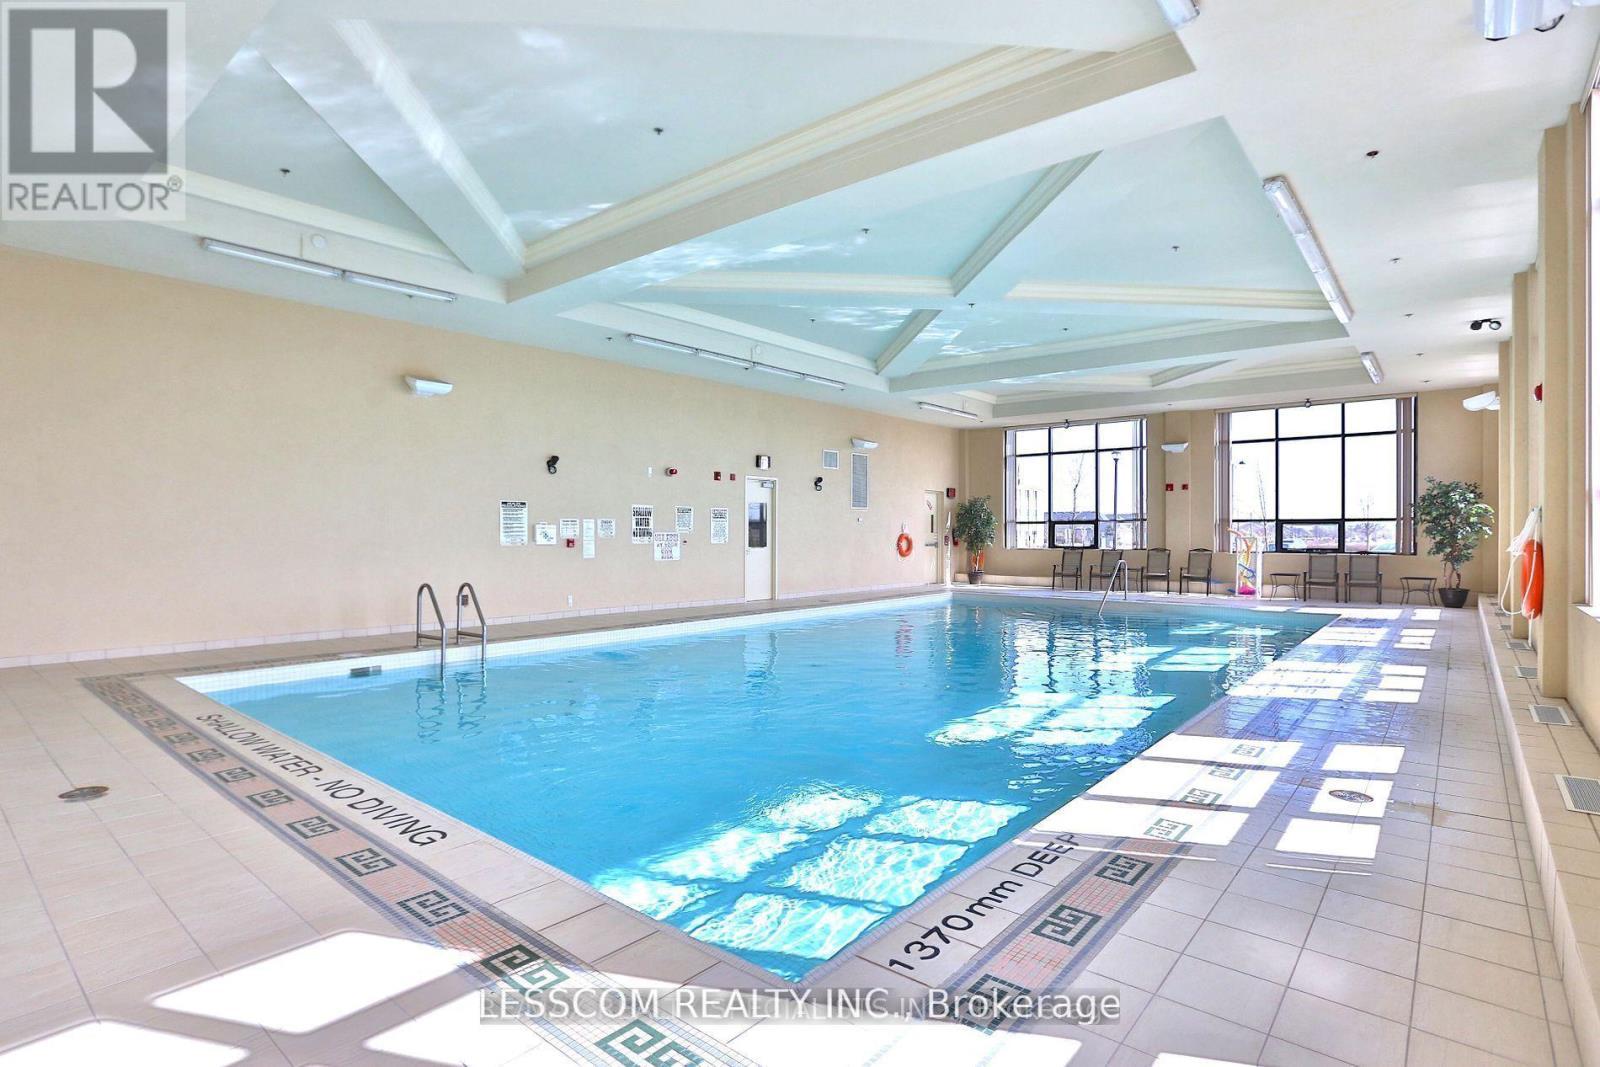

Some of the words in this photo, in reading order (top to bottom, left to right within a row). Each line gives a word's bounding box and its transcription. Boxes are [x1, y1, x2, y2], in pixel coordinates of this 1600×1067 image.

[196, 714, 271, 746] SHALLOW
[251, 743, 323, 777] WATER
[315, 779, 365, 800] NO
[346, 797, 448, 847] DIVING
[1010, 832, 1081, 878] DEEP
